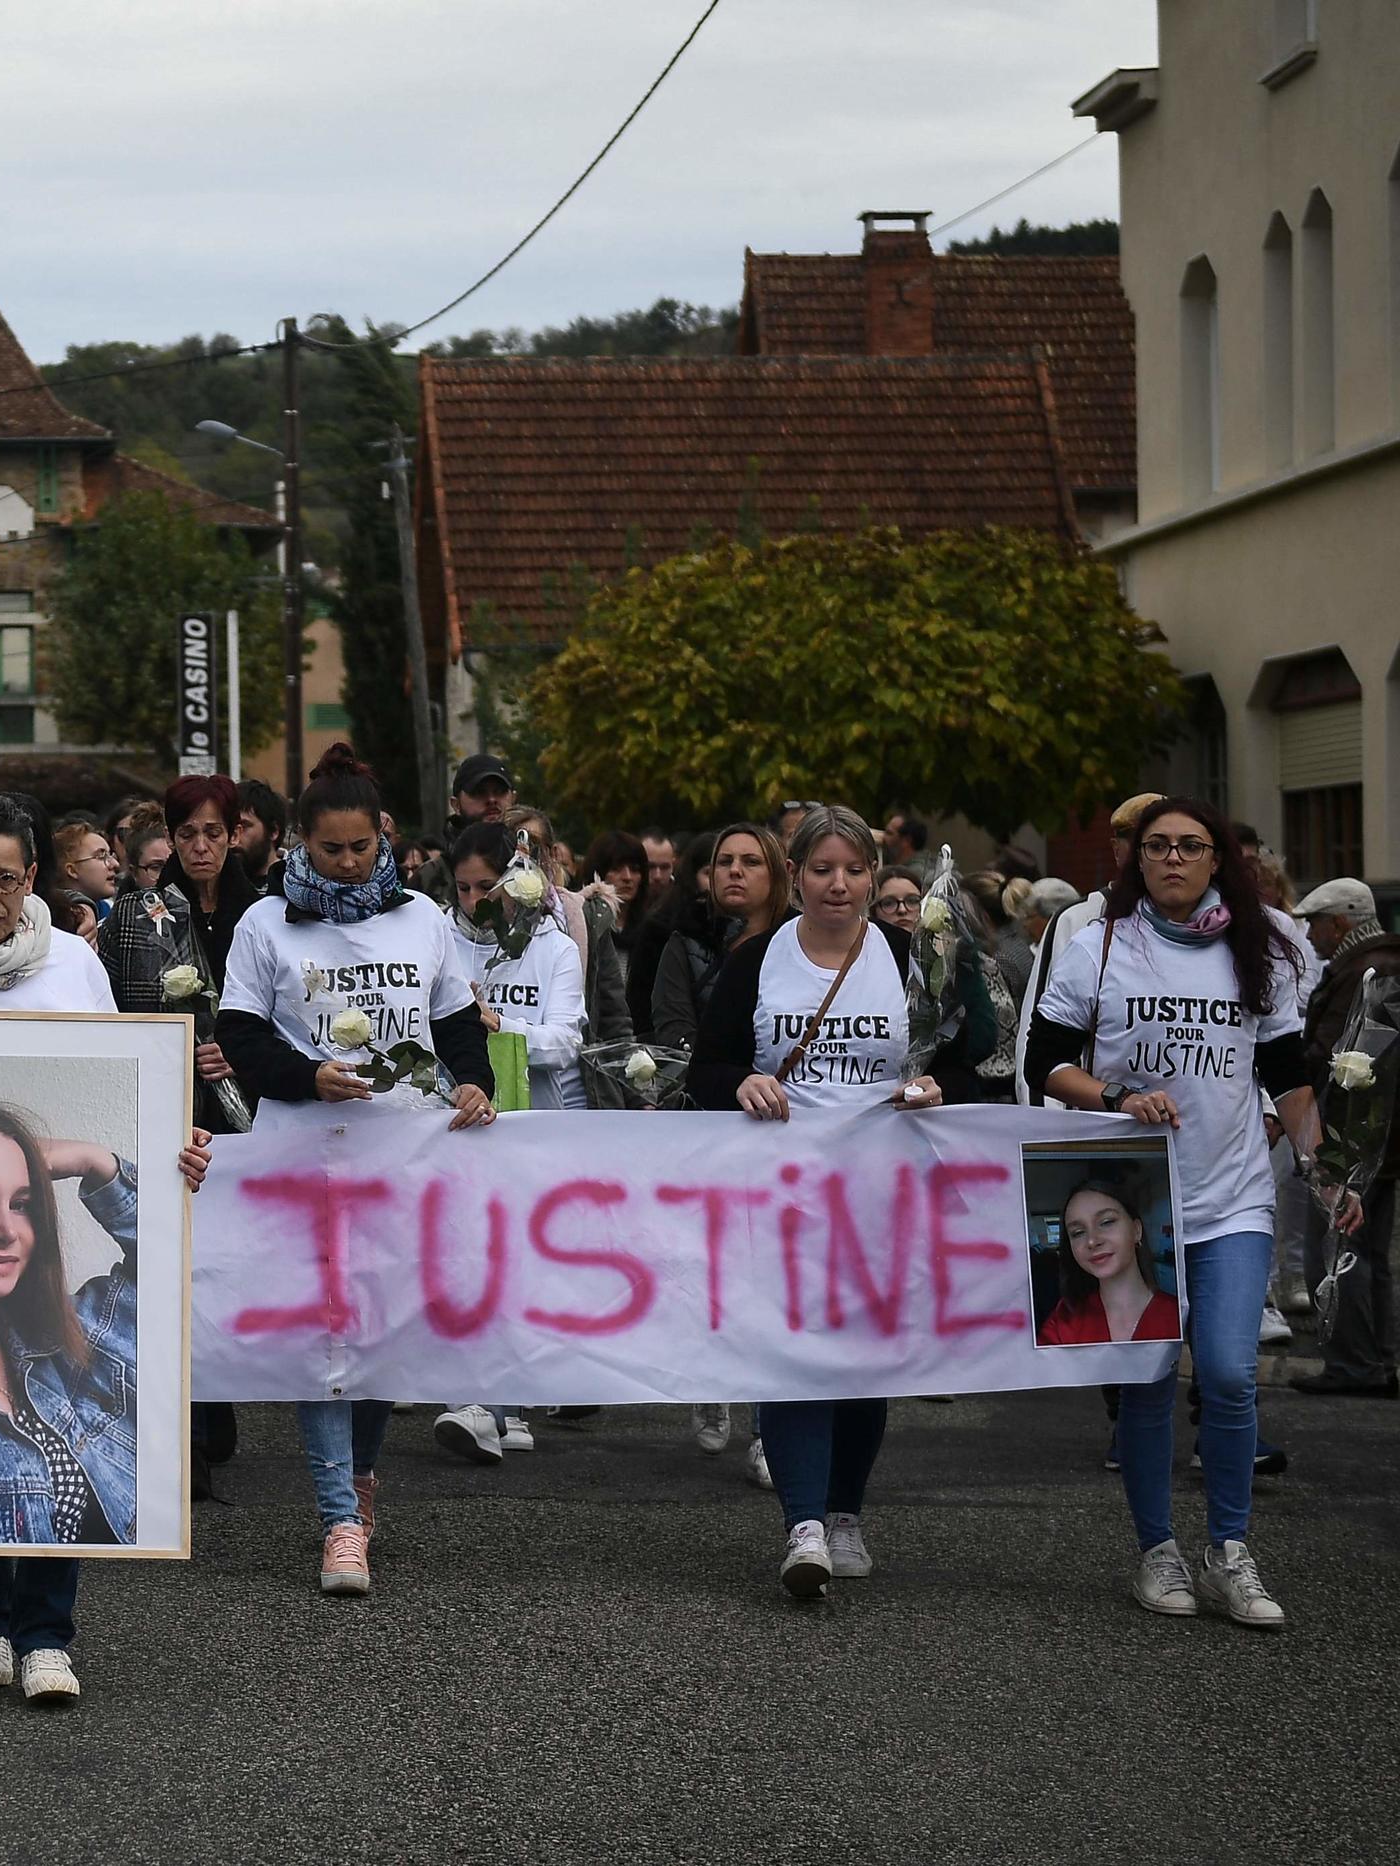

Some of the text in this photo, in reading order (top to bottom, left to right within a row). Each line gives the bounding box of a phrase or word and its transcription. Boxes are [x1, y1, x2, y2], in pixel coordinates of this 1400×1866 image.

[183, 618, 208, 723] CASINO
[347, 993, 386, 1008] POUR
[486, 984, 539, 1006] TICE
[1126, 996, 1242, 1029] JUSTICE
[1165, 1027, 1205, 1041] POUR
[809, 1042, 848, 1054] POUR
[1128, 1041, 1236, 1078] JUSTINE
[782, 1057, 887, 1084] USTINE
